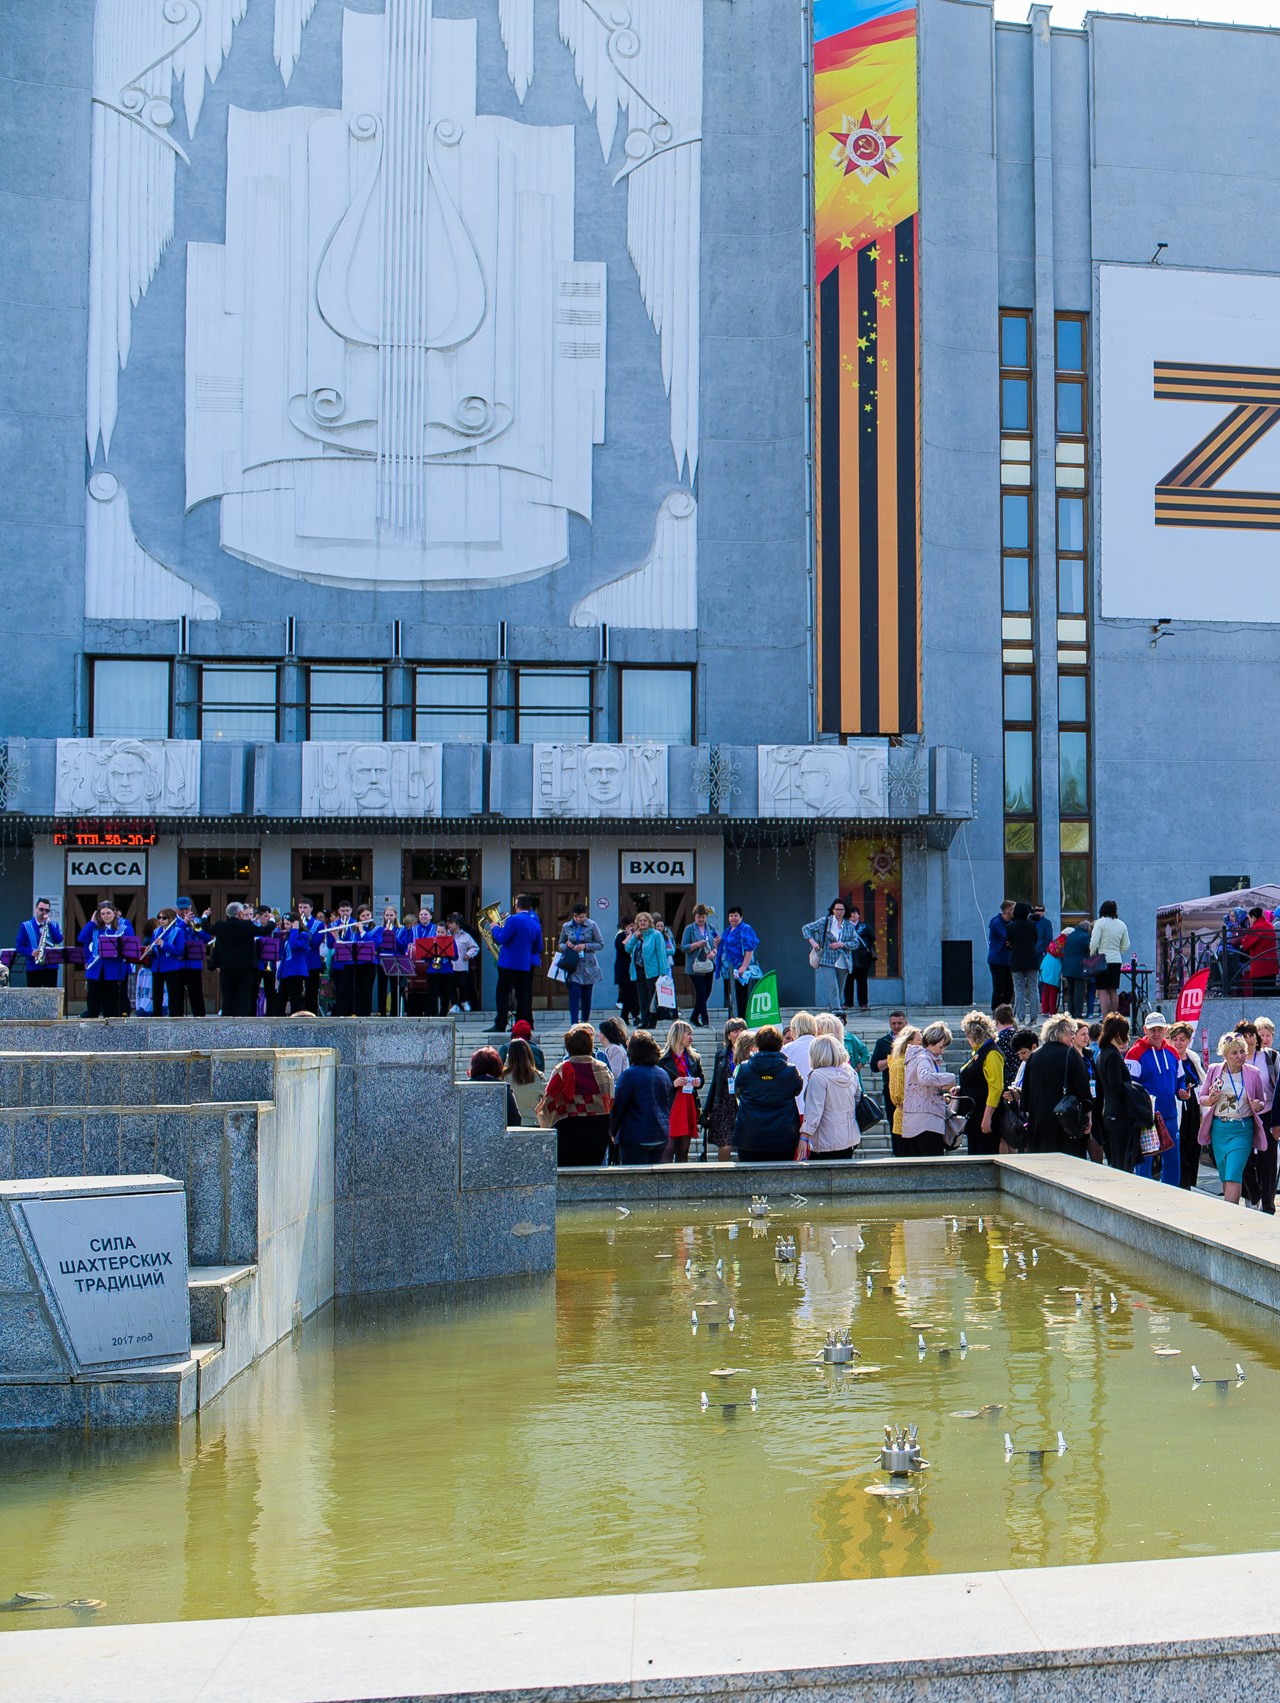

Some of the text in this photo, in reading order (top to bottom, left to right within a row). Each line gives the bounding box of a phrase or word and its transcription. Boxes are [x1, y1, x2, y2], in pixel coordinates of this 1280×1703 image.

[71, 861, 143, 876] КАССА
[630, 861, 686, 877] ВХОД
[750, 992, 772, 1013] ГТО
[1181, 988, 1203, 1009] ГТО
[90, 1236, 136, 1252] СИЛА
[59, 1252, 173, 1274] ШАХТЕРСКИХ
[75, 1269, 164, 1293] ТРАДИЦИЙ
[112, 1336, 134, 1347] 2017
